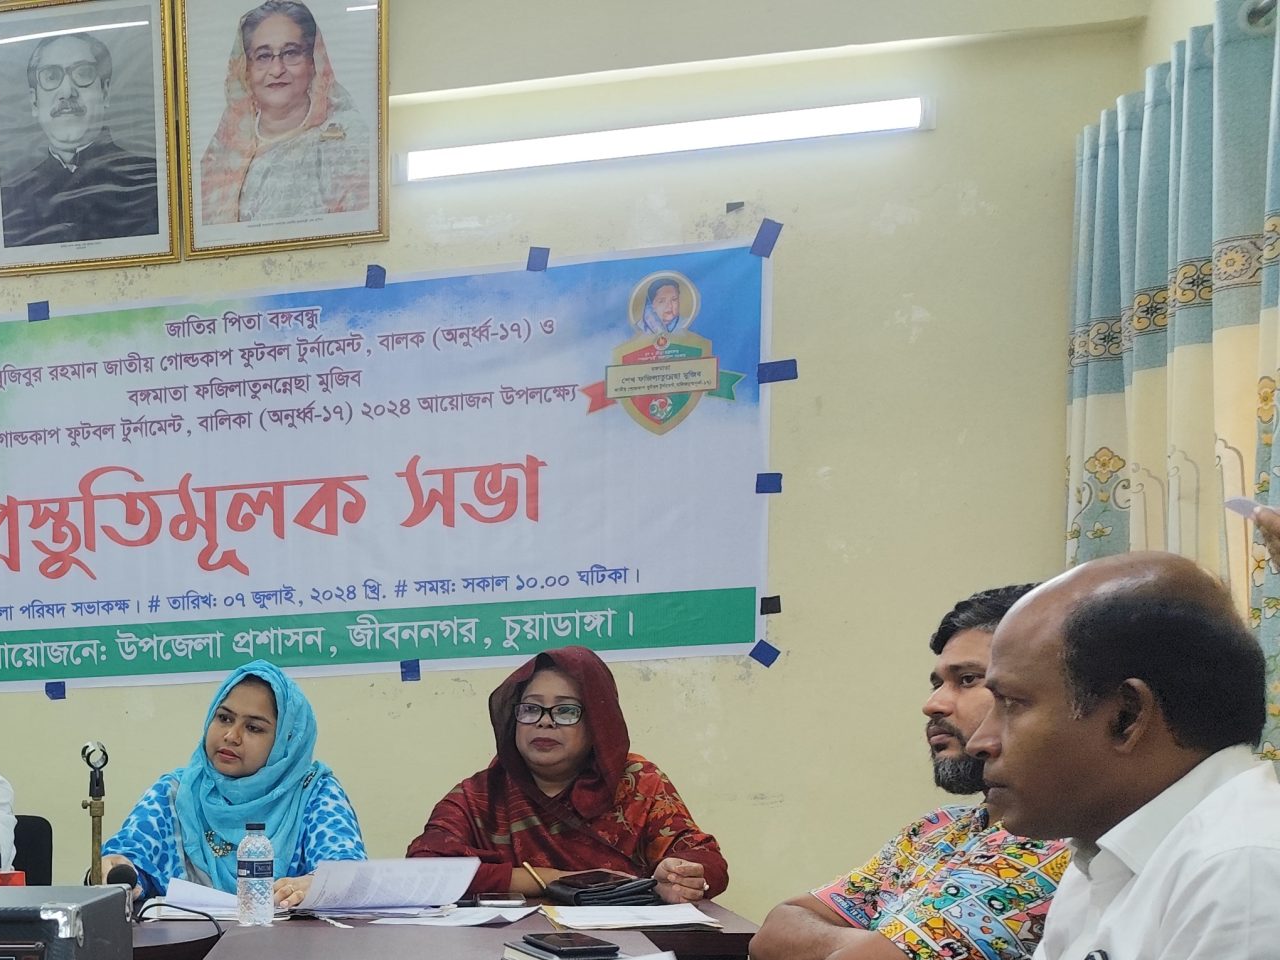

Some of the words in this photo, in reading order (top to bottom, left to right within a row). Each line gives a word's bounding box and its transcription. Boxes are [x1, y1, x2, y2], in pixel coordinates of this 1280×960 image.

[166, 314, 216, 340] জাতির
[223, 310, 262, 334] পিতা
[268, 306, 320, 330] বঙ্গবন্ধু
[49, 360, 96, 384] রহমান
[104, 353, 155, 378] জাতীয়
[160, 349, 232, 375] গোল্ডকাপ
[239, 345, 289, 371] ফুটবল
[380, 331, 425, 350] বালক
[538, 318, 555, 336] ও
[128, 383, 187, 408] বঙ্গমাতা
[316, 369, 362, 392] মুজিব
[66, 423, 115, 447] ফুটবল
[197, 410, 252, 433] বালিকা
[360, 399, 411, 419] ২০২৪
[396, 454, 548, 529] সভা
[20, 600, 66, 620] পরিষদ
[148, 598, 160, 612] #
[167, 591, 217, 612] তারিখ:
[223, 591, 246, 608] ০৭
[310, 583, 356, 603] ২০২৪
[394, 581, 407, 596] #
[463, 574, 508, 593] সকাল
[516, 572, 570, 591] ১০.০০
[116, 629, 223, 662] উপজেলা
